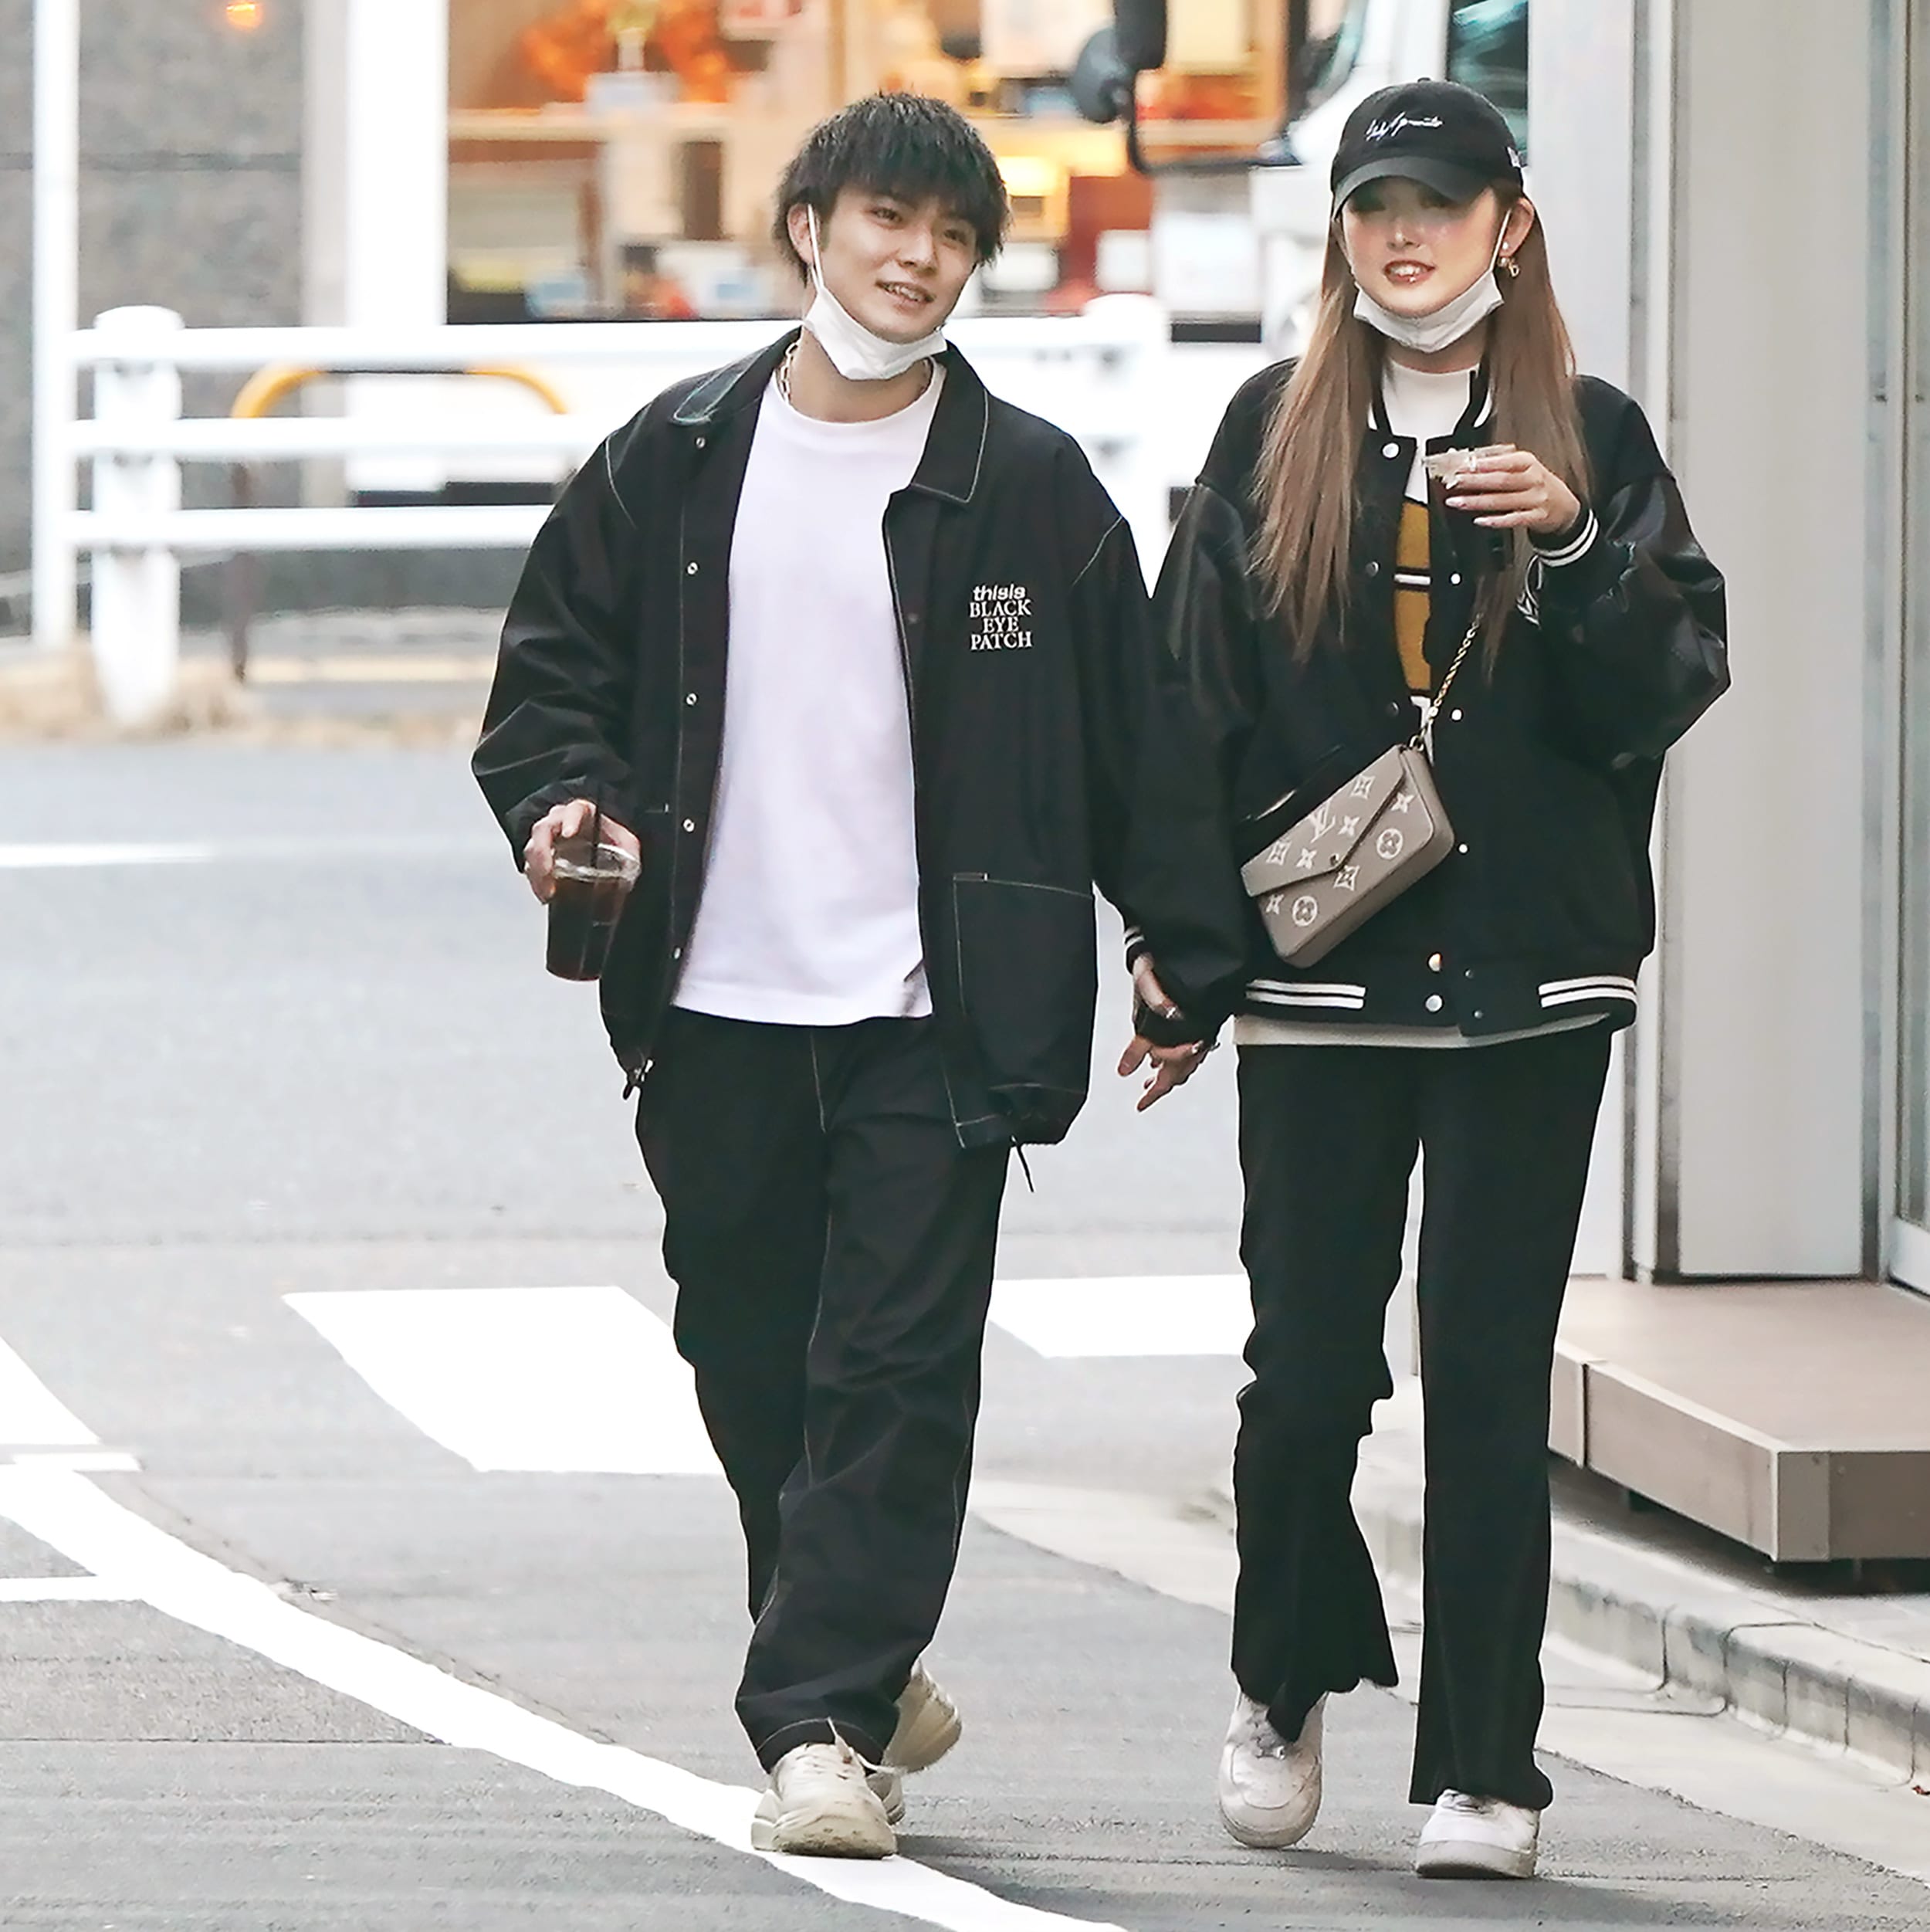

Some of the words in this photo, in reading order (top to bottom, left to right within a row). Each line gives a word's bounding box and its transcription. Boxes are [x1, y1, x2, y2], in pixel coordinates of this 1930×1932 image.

[970, 599, 1032, 618] BLACK
[982, 616, 1019, 634] EYE
[970, 631, 1033, 650] PATCH
